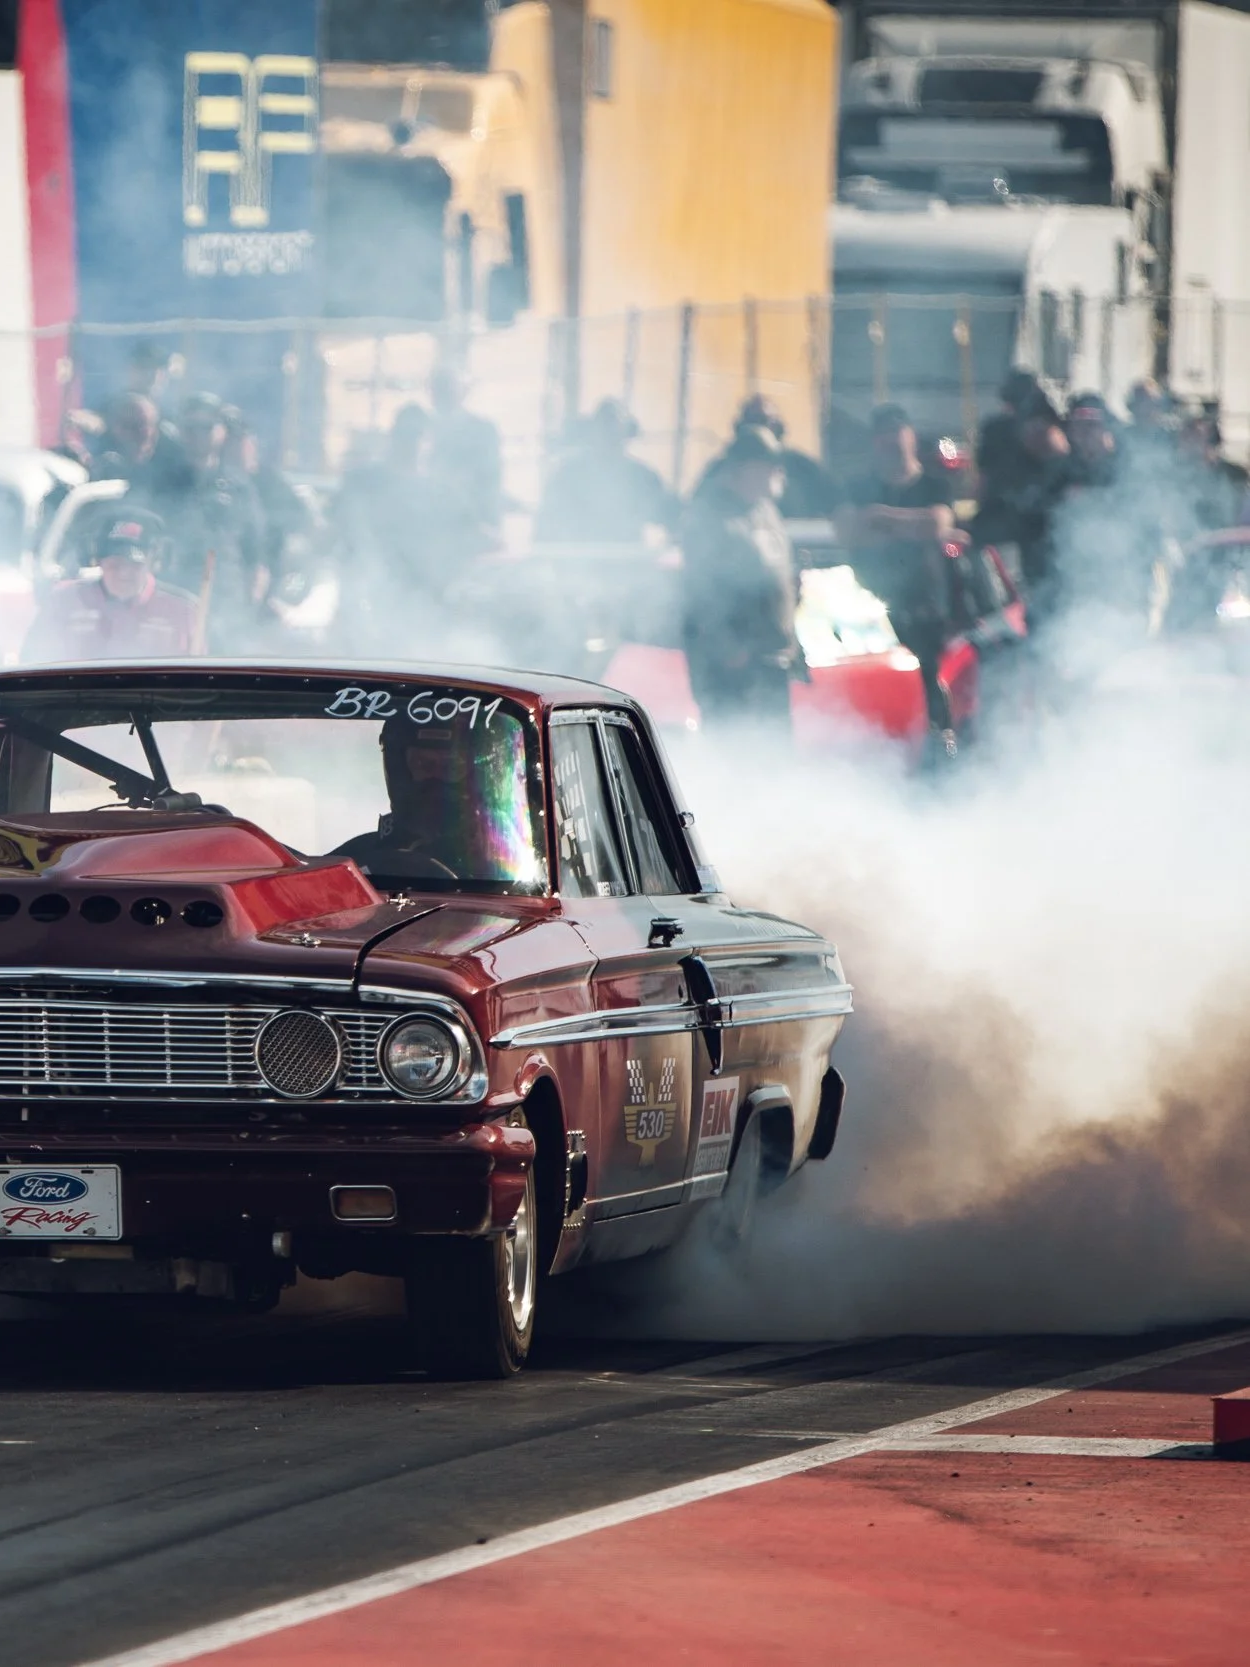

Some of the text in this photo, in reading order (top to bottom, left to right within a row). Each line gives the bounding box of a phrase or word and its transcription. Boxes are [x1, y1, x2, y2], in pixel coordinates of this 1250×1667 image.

[324, 686, 504, 730] BR 6091
[637, 1110, 665, 1139] 530
[700, 1087, 737, 1139] EIK
[19, 1176, 71, 1199] Ford
[0, 1206, 98, 1233] Racing
